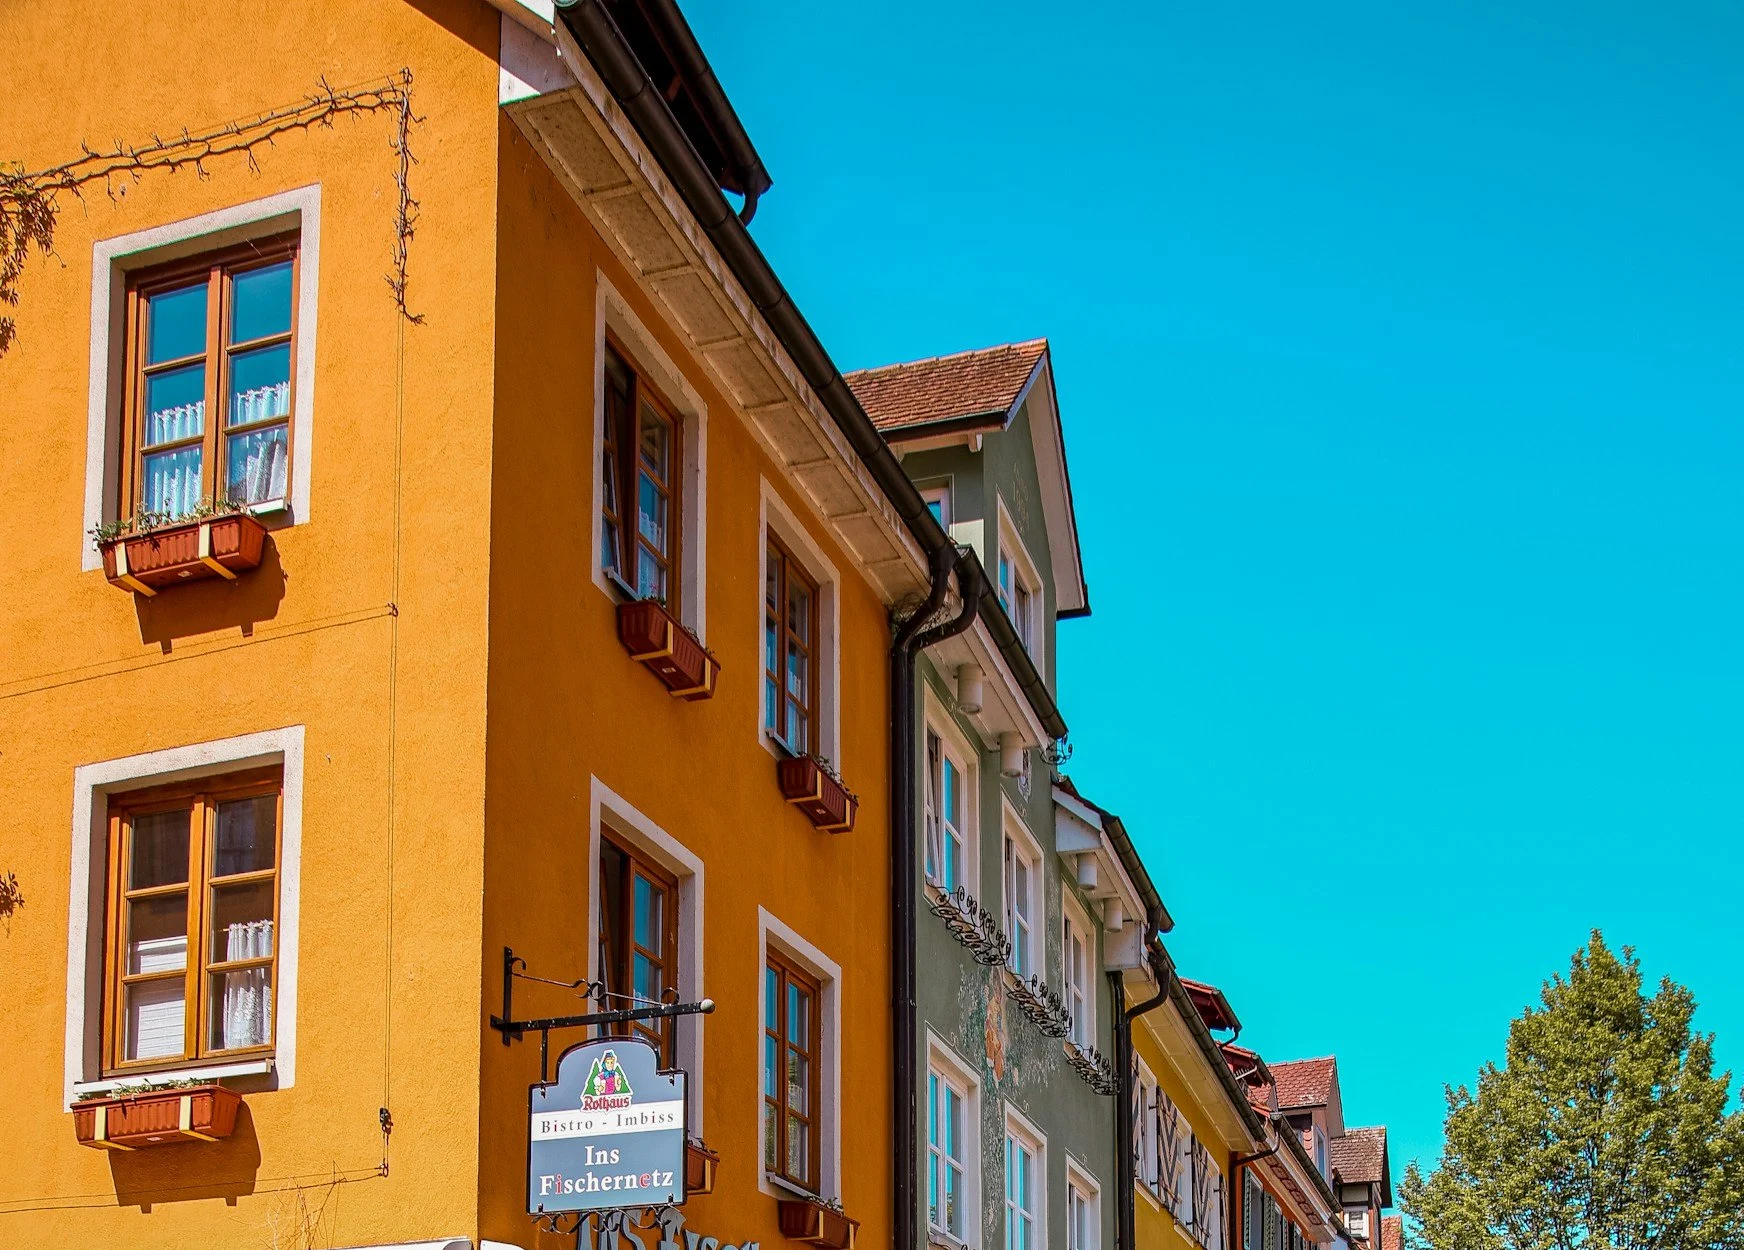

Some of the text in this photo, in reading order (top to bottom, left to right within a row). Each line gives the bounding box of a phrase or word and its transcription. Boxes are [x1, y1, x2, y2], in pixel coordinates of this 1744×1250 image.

[582, 1095, 630, 1112] Rothaus
[541, 1118, 593, 1133] Bistro
[617, 1111, 674, 1126] Imbiss
[584, 1145, 620, 1166] Ins
[539, 1171, 673, 1196] Fischernetz
